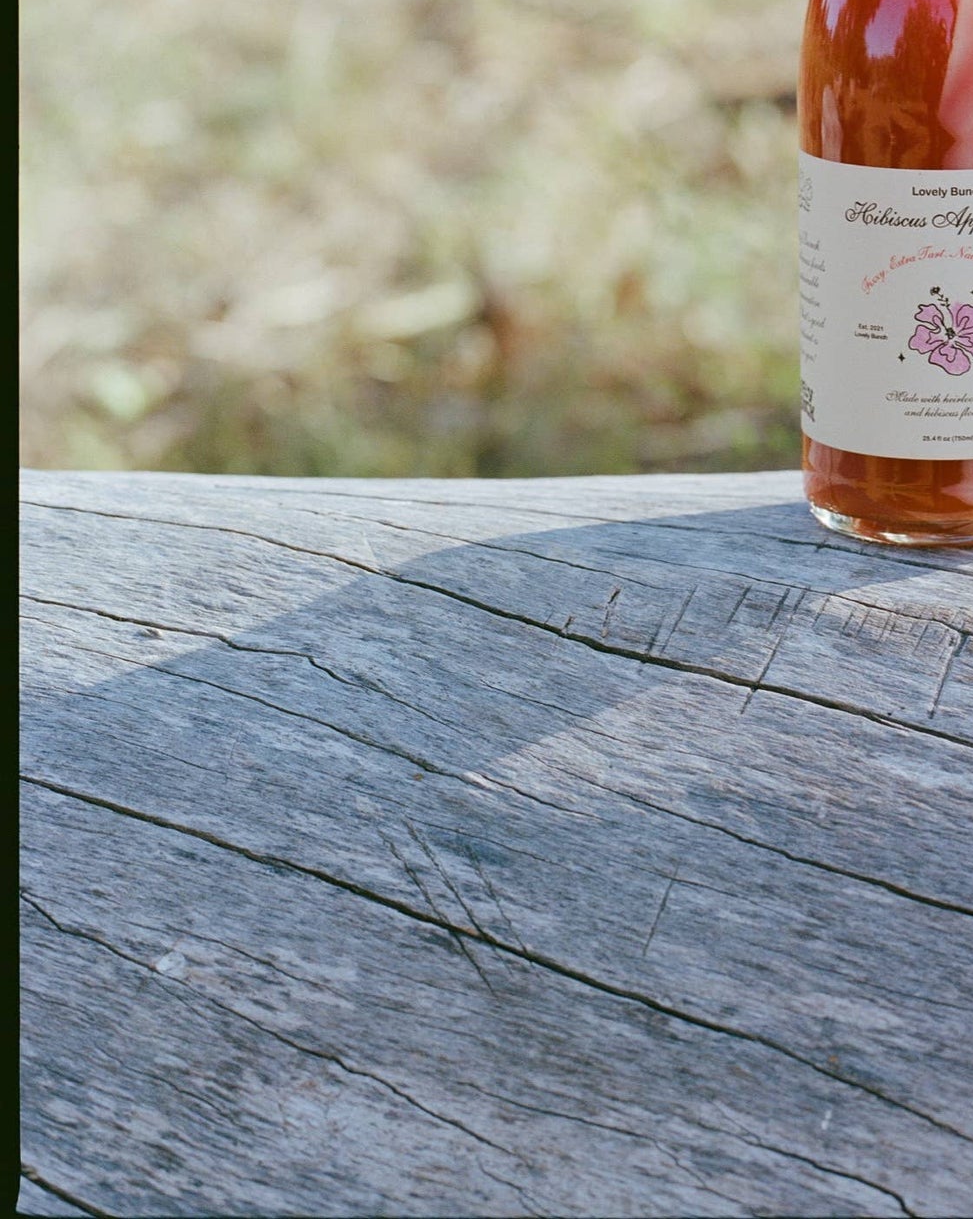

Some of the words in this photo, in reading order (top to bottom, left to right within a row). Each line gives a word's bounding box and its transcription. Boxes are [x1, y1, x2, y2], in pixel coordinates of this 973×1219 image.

[912, 186, 947, 198] Lovely
[845, 201, 927, 228] Hibiscus
[854, 331, 870, 339] Lovely
[885, 390, 919, 402] Made
[920, 393, 941, 403] with
[904, 407, 923, 417] and
[924, 407, 959, 417] hibiscus
